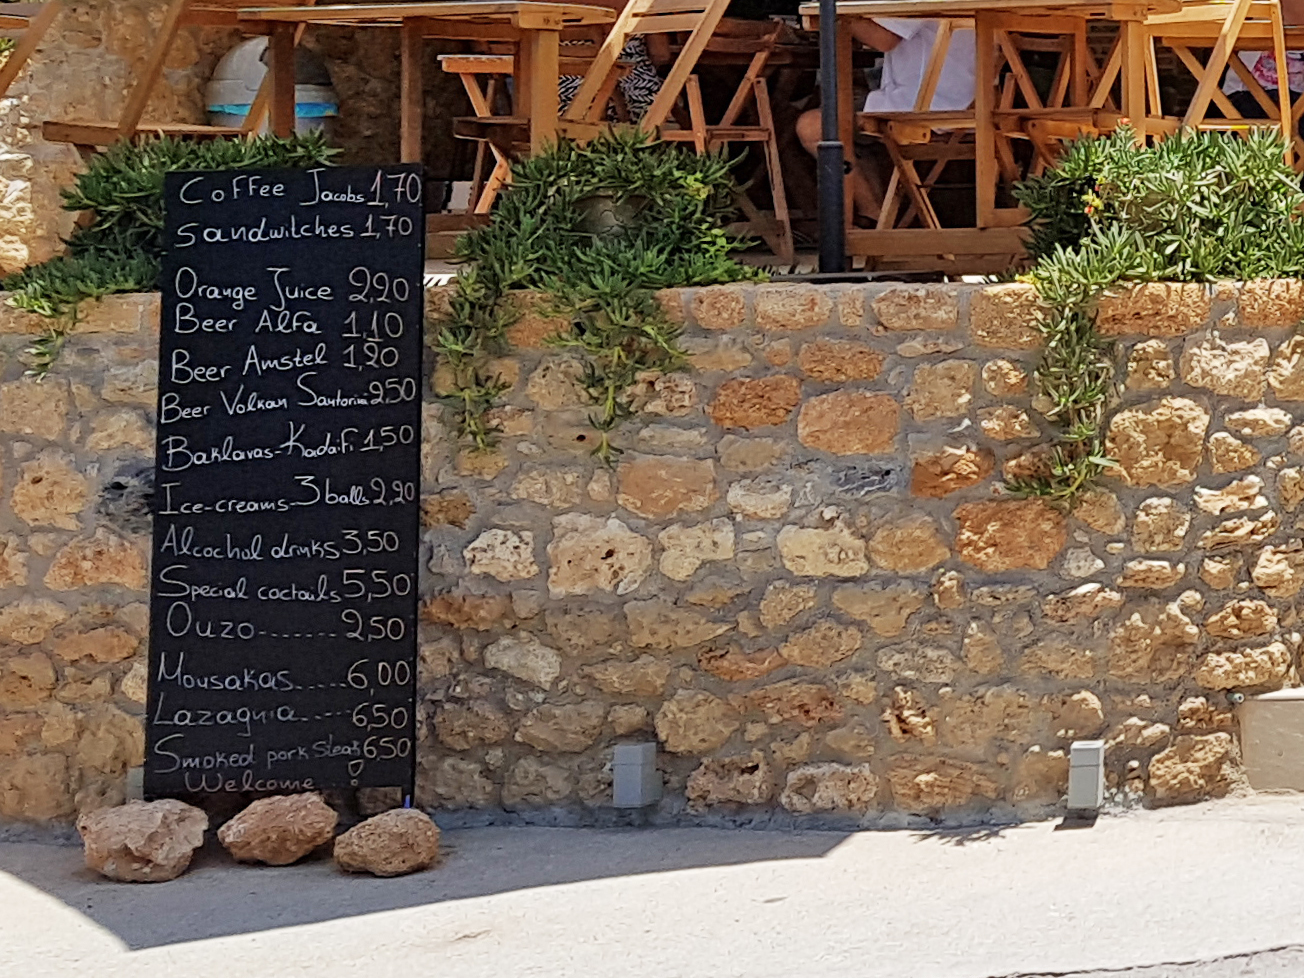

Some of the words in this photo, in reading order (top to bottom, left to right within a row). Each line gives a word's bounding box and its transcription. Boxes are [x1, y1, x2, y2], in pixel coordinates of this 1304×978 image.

[299, 168, 365, 206] Jacobs
[175, 266, 258, 311] Orange
[265, 267, 335, 311] Juice
[174, 302, 239, 334] Beer
[170, 349, 233, 384] Beer
[242, 342, 329, 376] Amstel
[160, 392, 211, 424] Beer
[220, 384, 288, 415] Volkan
[157, 564, 249, 602] Special
[154, 733, 256, 774] Smoked
[266, 745, 310, 770] pork
[185, 770, 316, 794] Welcome
